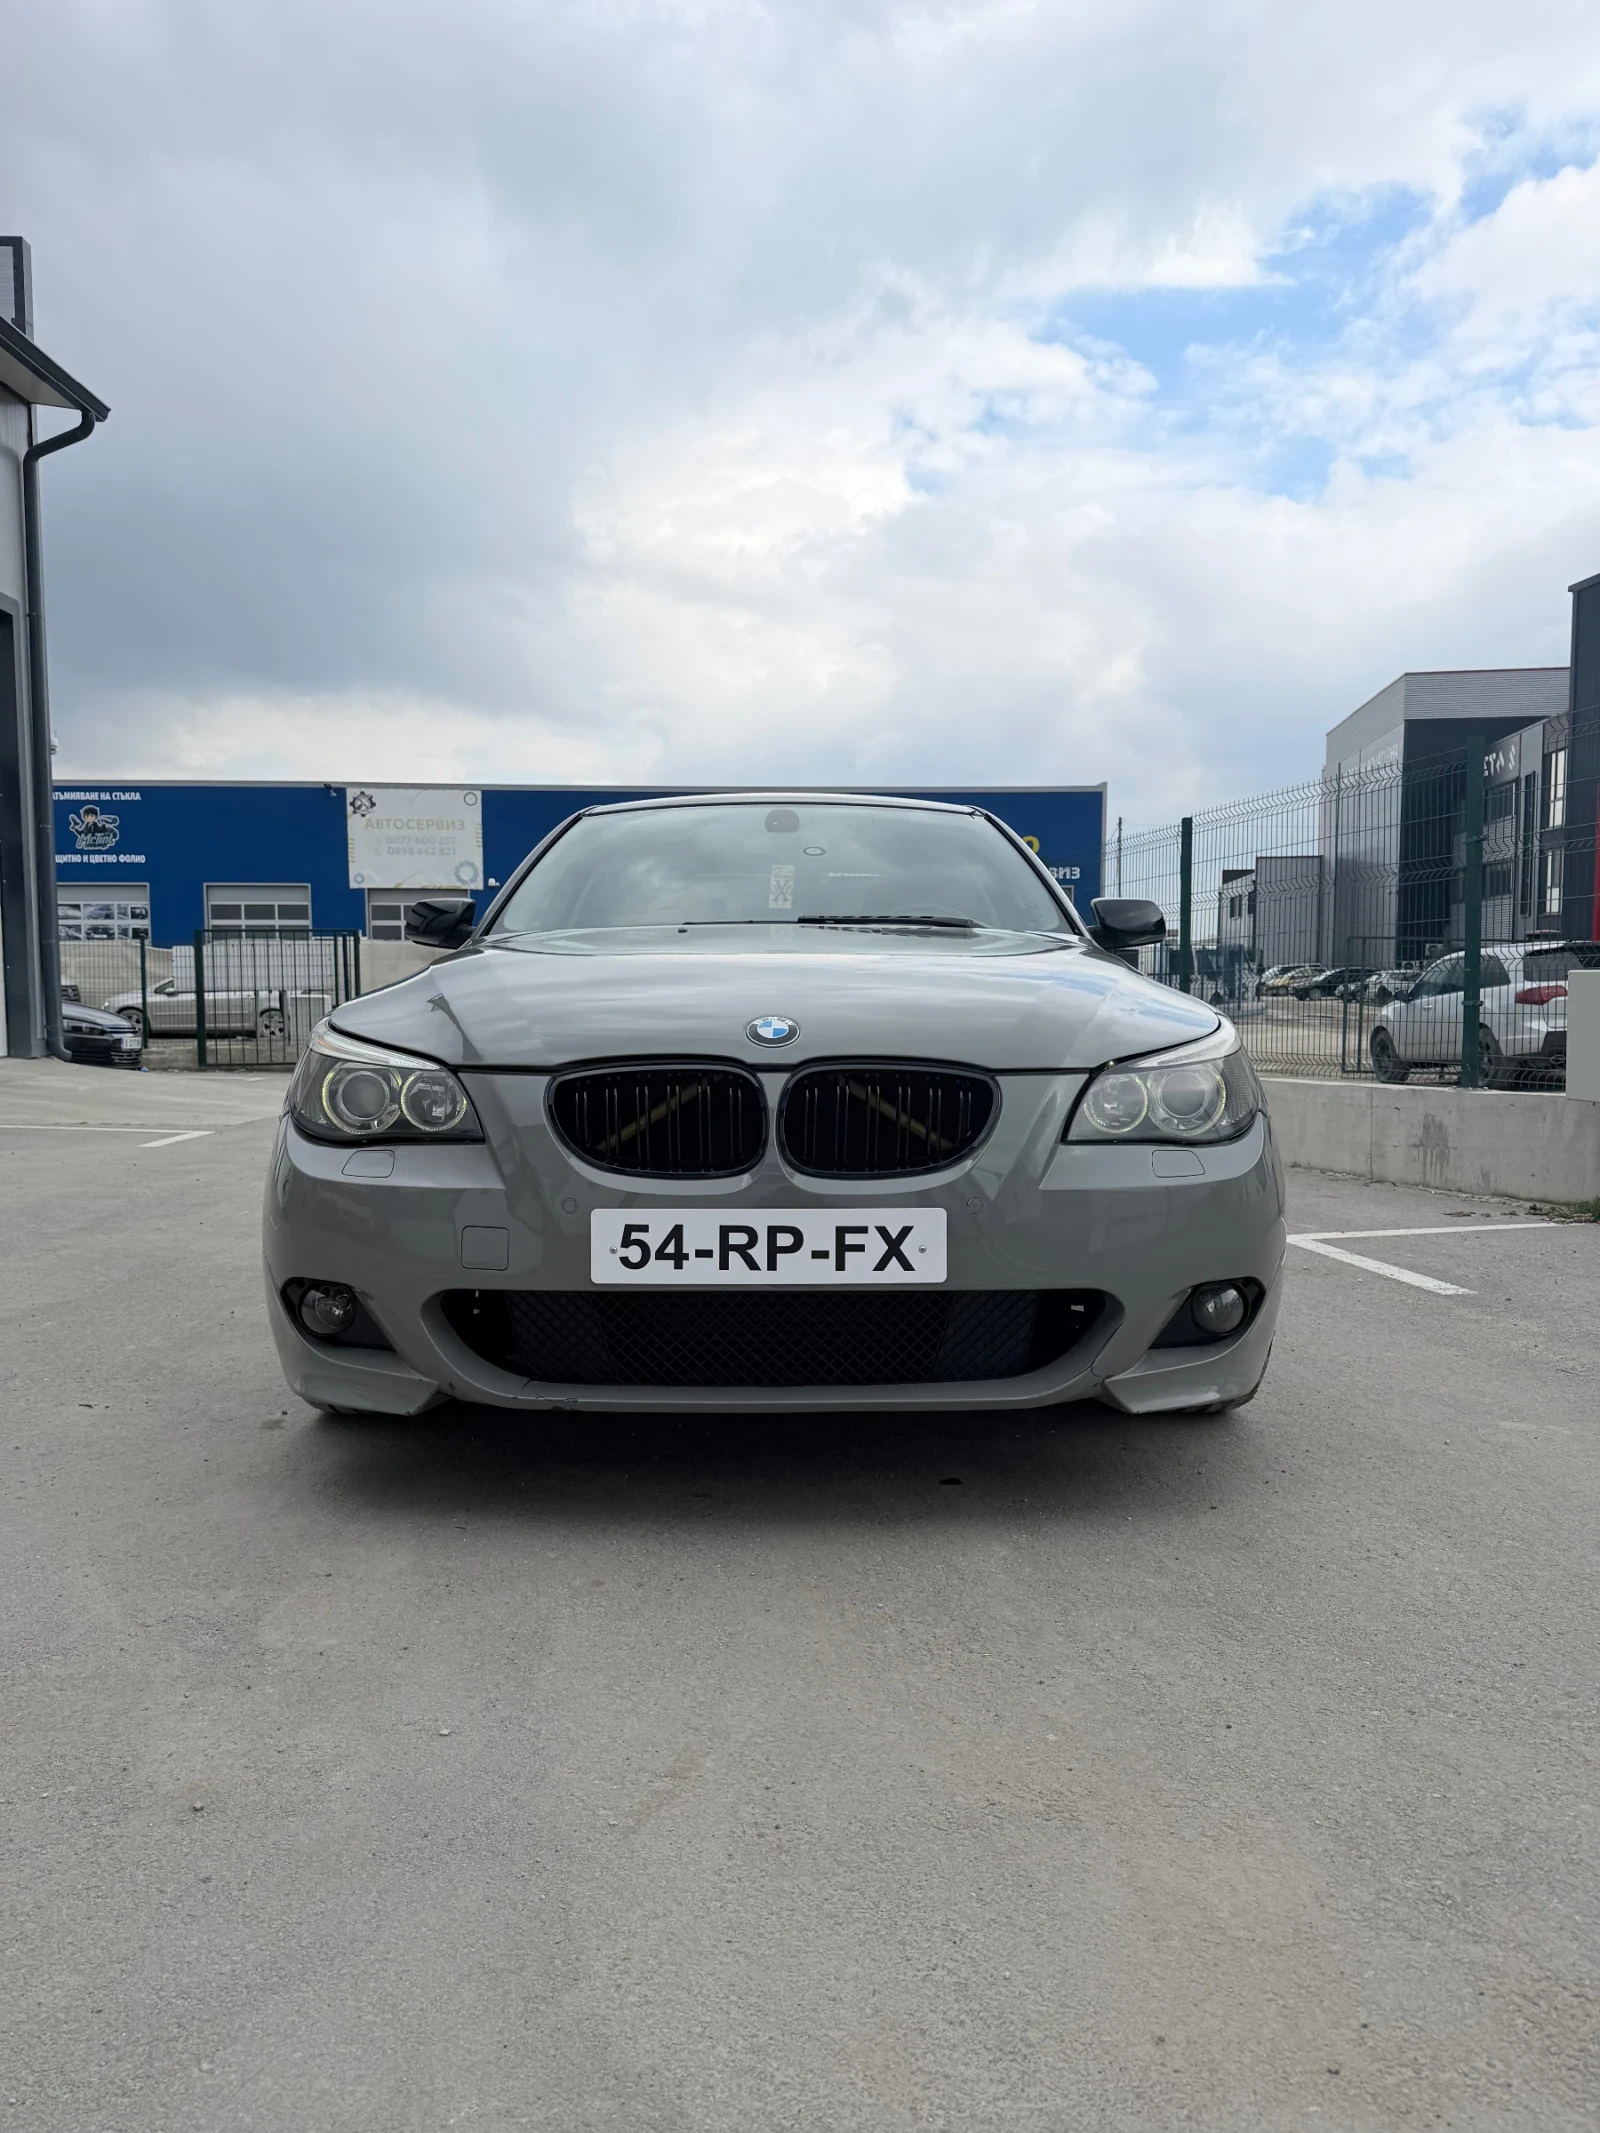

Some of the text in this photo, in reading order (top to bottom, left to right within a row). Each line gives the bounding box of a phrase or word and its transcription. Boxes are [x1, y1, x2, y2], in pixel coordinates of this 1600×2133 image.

[100, 791, 111, 801] НА
[112, 791, 142, 801] СТЪКЛА
[365, 818, 466, 831] АВТОСЕРВИЗ
[387, 846, 414, 856] 0898
[89, 854, 118, 865] ЦВЕТНО
[118, 854, 146, 864] ФОЛИО
[619, 1223, 916, 1272] 54-RP-FX
